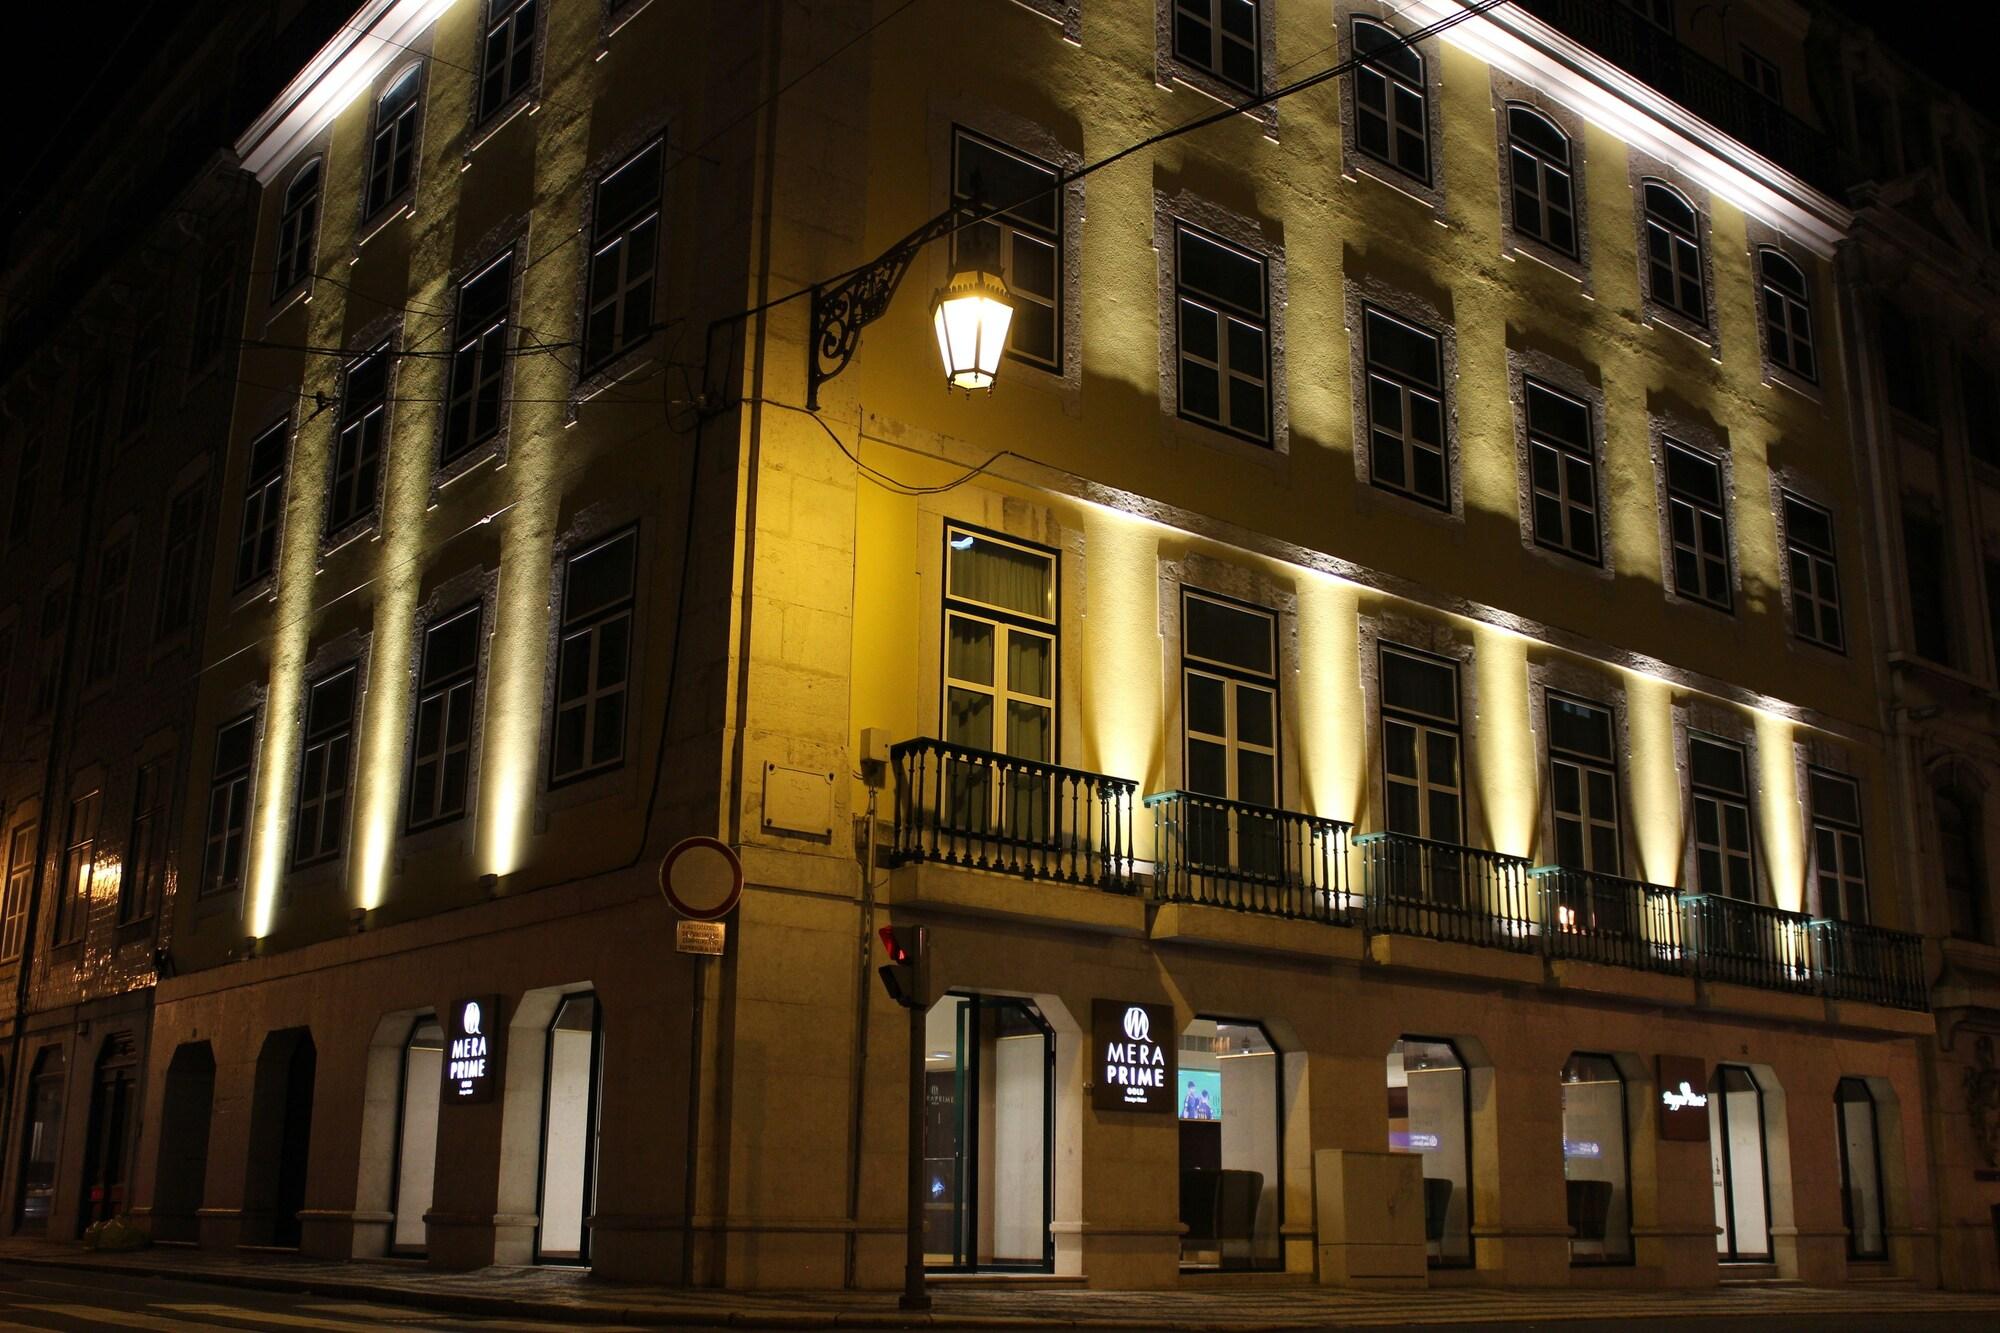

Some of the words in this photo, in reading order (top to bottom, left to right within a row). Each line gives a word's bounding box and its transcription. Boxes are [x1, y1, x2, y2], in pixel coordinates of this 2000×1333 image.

[451, 1036, 487, 1059] MERA
[1106, 1042, 1165, 1066] MERA
[450, 1059, 486, 1080] PRIME
[1106, 1065, 1165, 1088] PRIME
